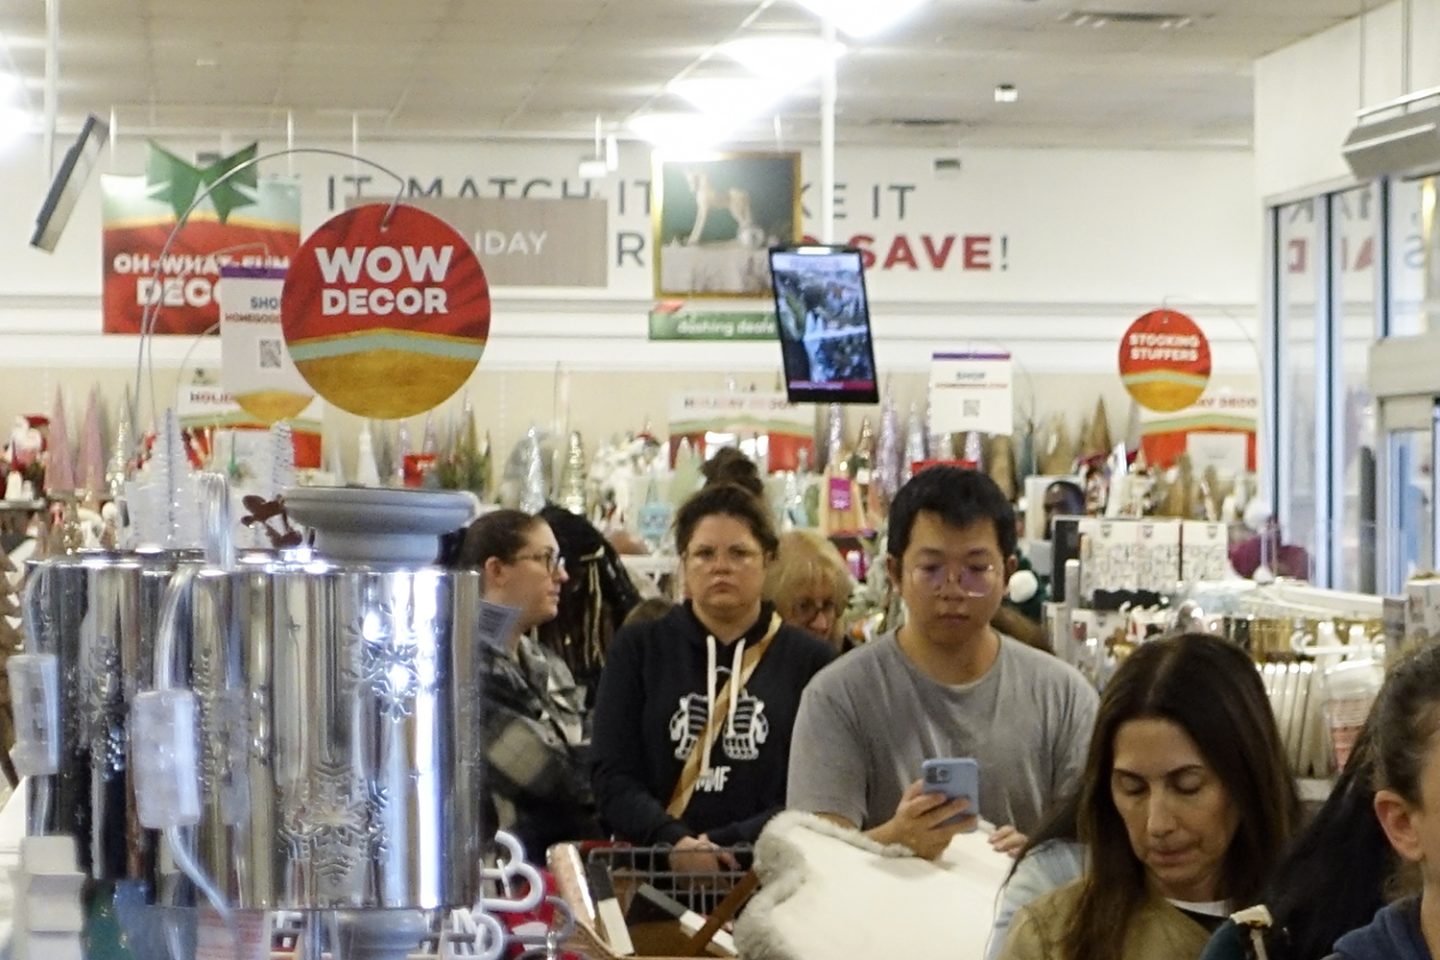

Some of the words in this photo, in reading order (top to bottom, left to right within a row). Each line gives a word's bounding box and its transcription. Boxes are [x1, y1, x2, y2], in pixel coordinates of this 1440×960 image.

[872, 184, 917, 221] IT
[474, 230, 548, 256] IDAY
[849, 233, 1008, 271] SAVE!
[313, 245, 454, 284] WOW
[136, 278, 221, 308] DEC
[250, 297, 279, 310] SHO
[321, 287, 449, 316] DECOR
